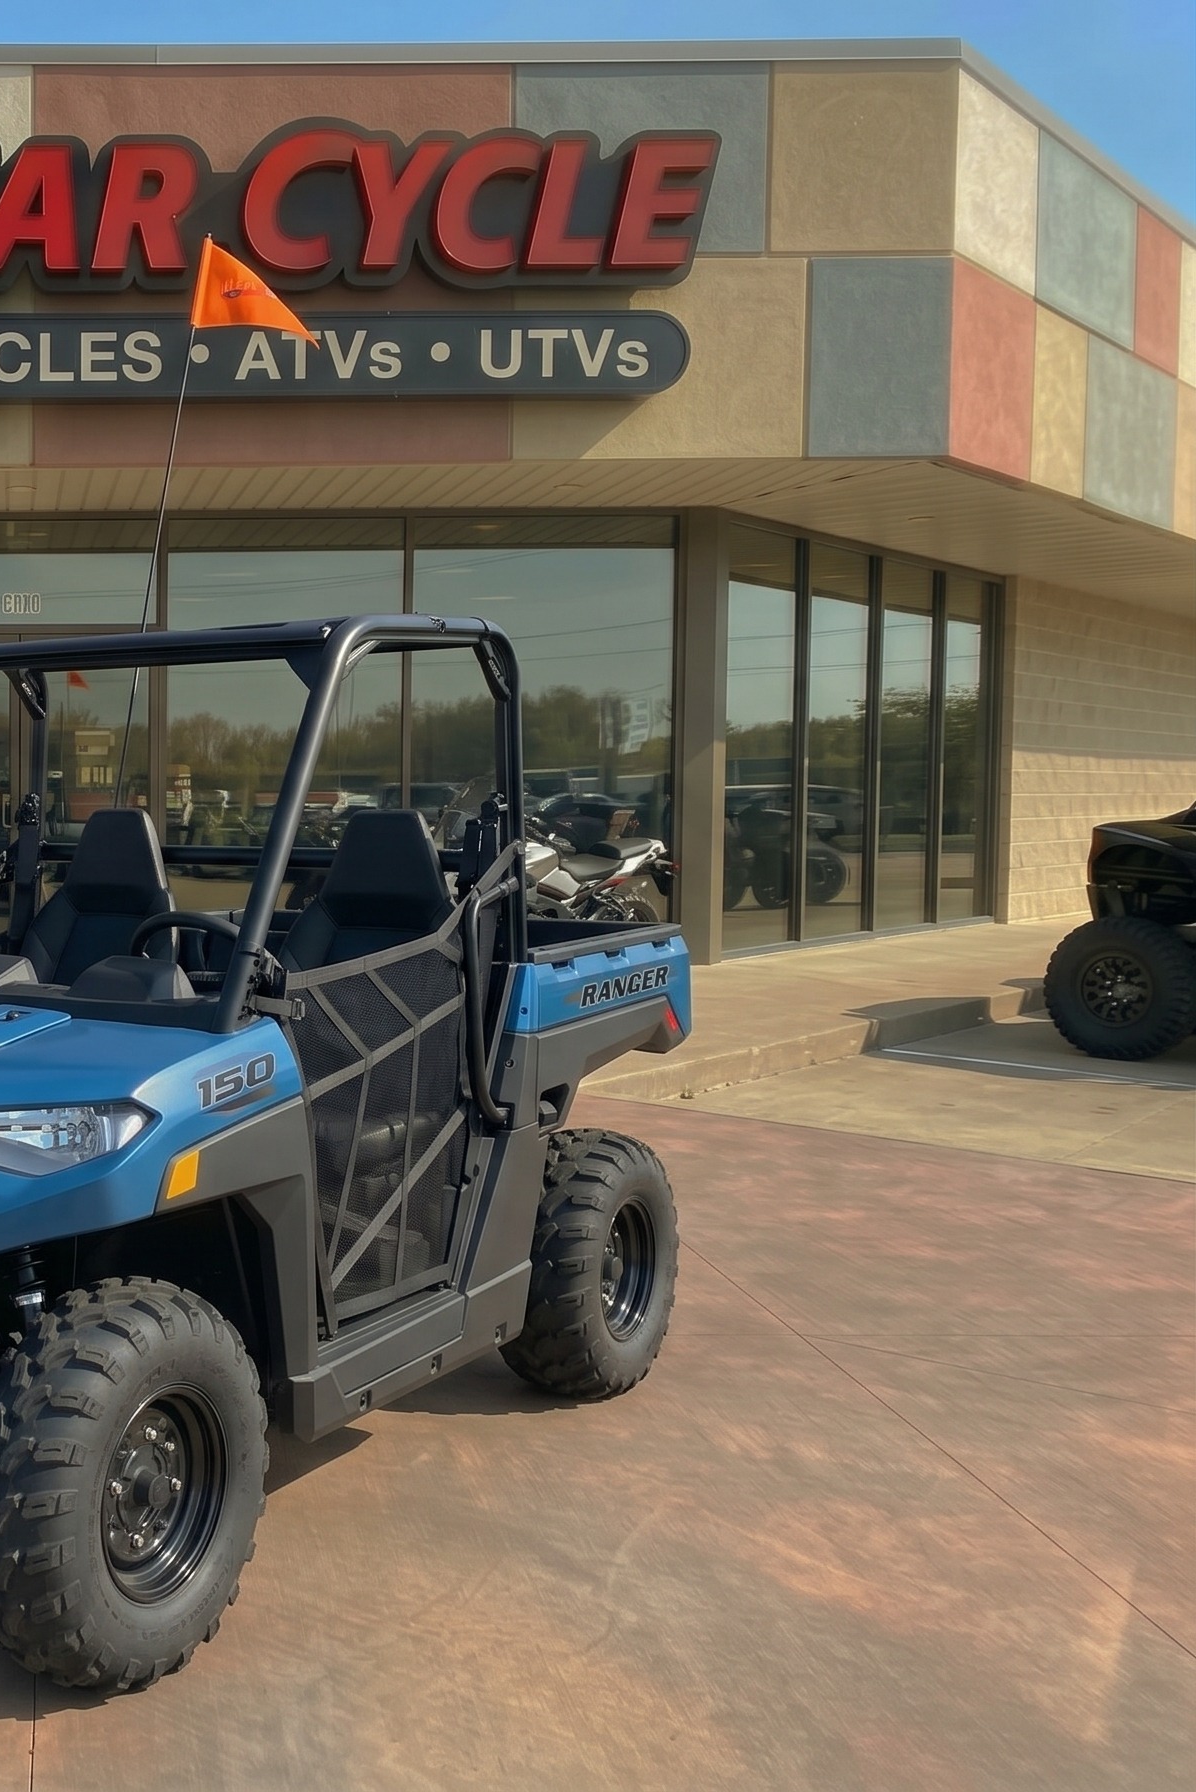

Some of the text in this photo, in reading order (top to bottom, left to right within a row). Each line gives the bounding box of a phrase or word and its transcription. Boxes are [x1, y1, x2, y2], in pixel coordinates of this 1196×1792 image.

[242, 128, 718, 273] CYCLE
[235, 330, 402, 380] ATVs
[480, 329, 650, 378] UTVs
[580, 965, 670, 1008] RANGER
[196, 1052, 276, 1110] 150
